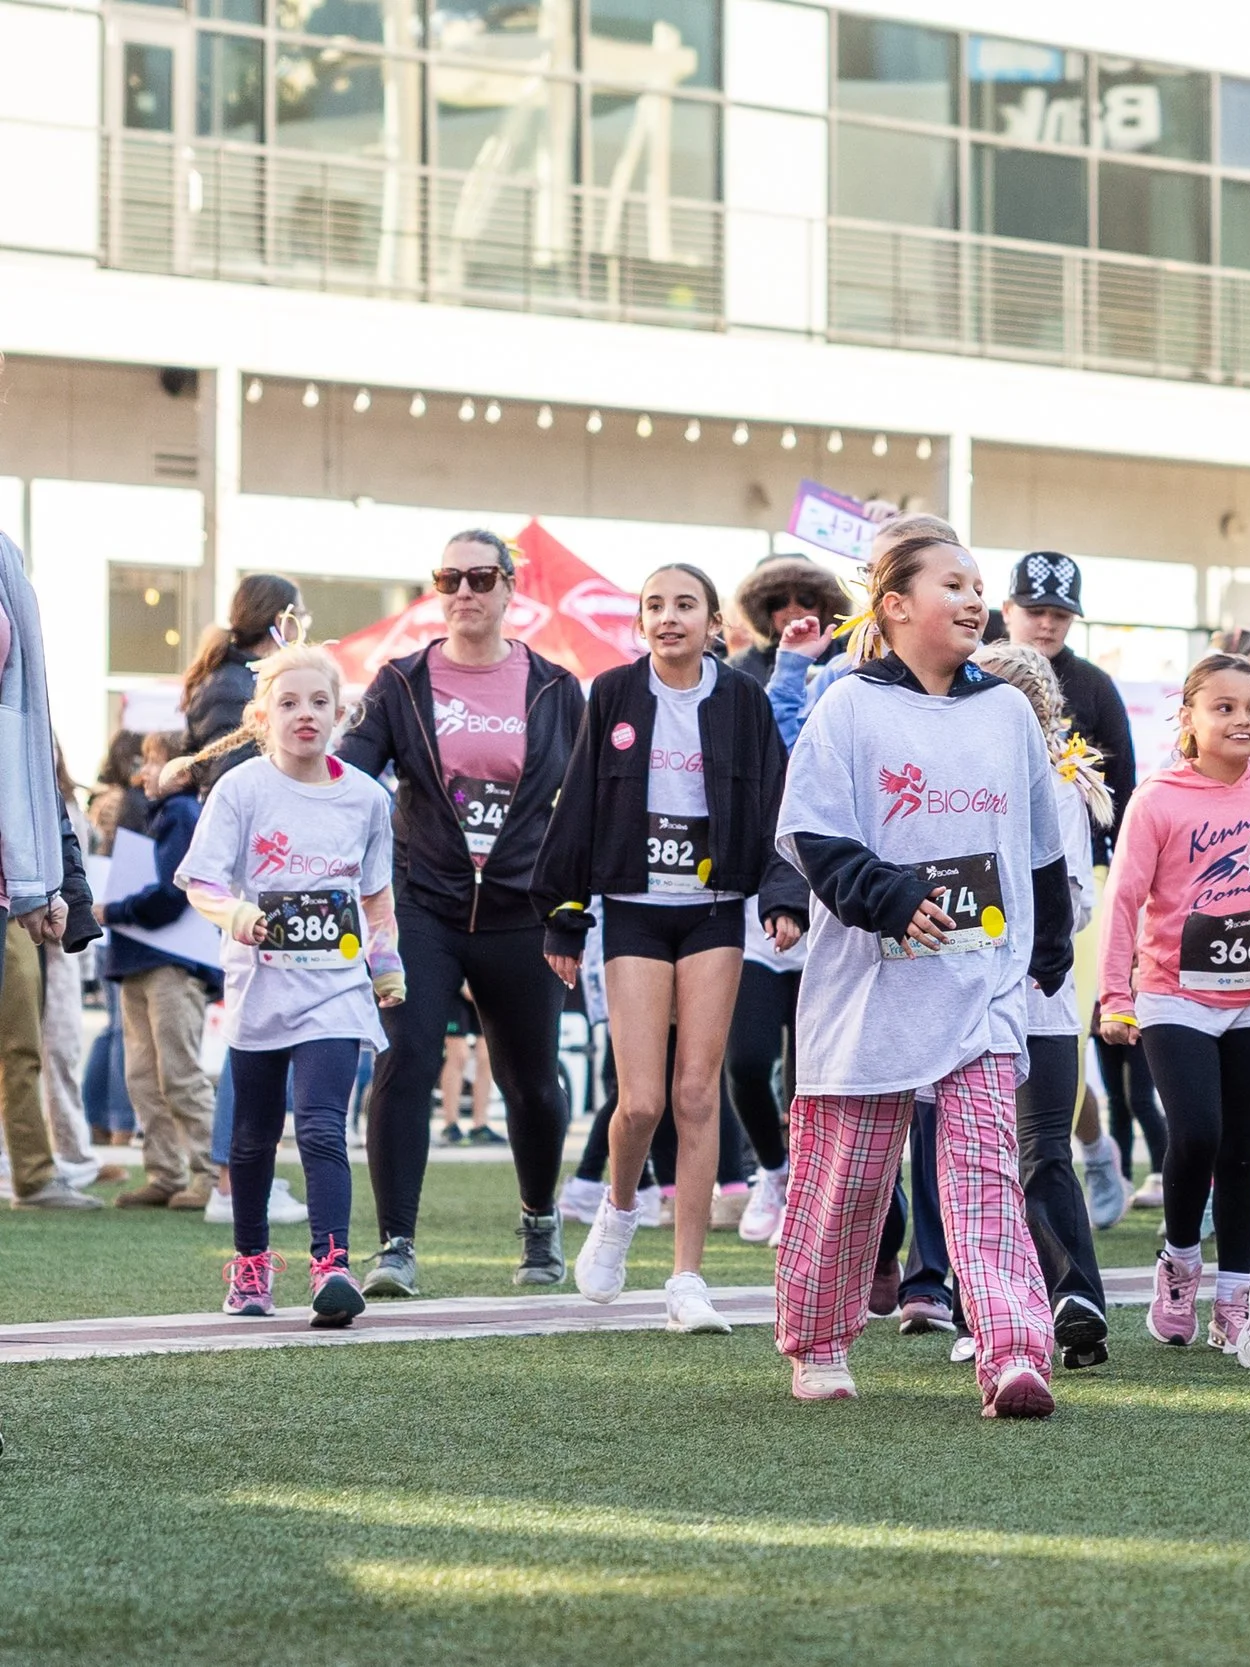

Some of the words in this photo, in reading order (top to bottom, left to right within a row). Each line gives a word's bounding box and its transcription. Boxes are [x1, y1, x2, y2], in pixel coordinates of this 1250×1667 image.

[928, 788, 1008, 815] BIOGirls
[647, 837, 694, 867] 382
[287, 914, 340, 942] 386
